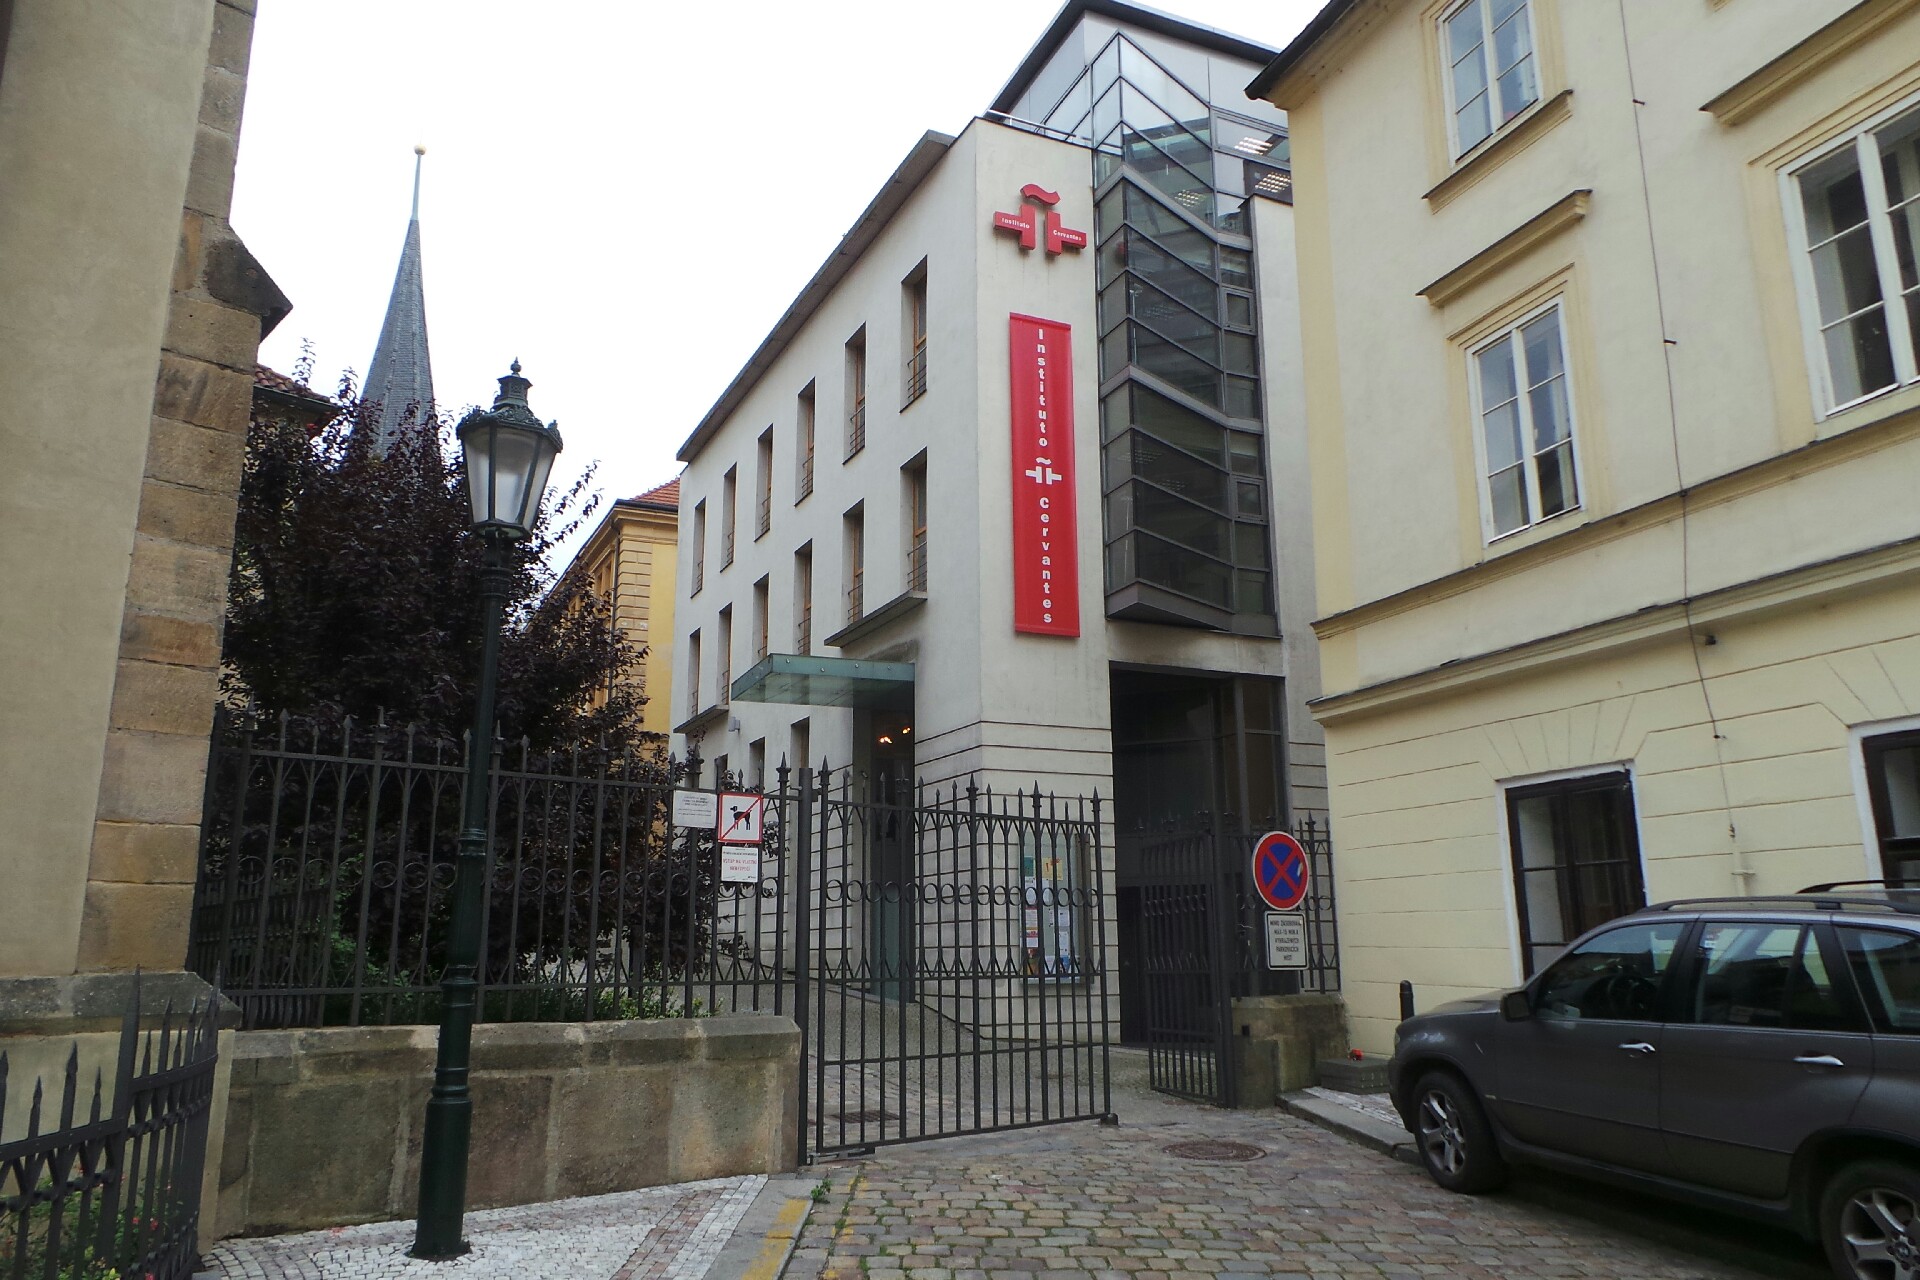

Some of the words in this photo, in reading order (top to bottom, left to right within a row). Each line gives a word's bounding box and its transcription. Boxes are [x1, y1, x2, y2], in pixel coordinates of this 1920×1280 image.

[1001, 217, 1030, 230] Instituto
[1053, 229, 1082, 241] Cervantes
[1037, 328, 1048, 447] Instituto
[1039, 496, 1052, 623] Cervantes
